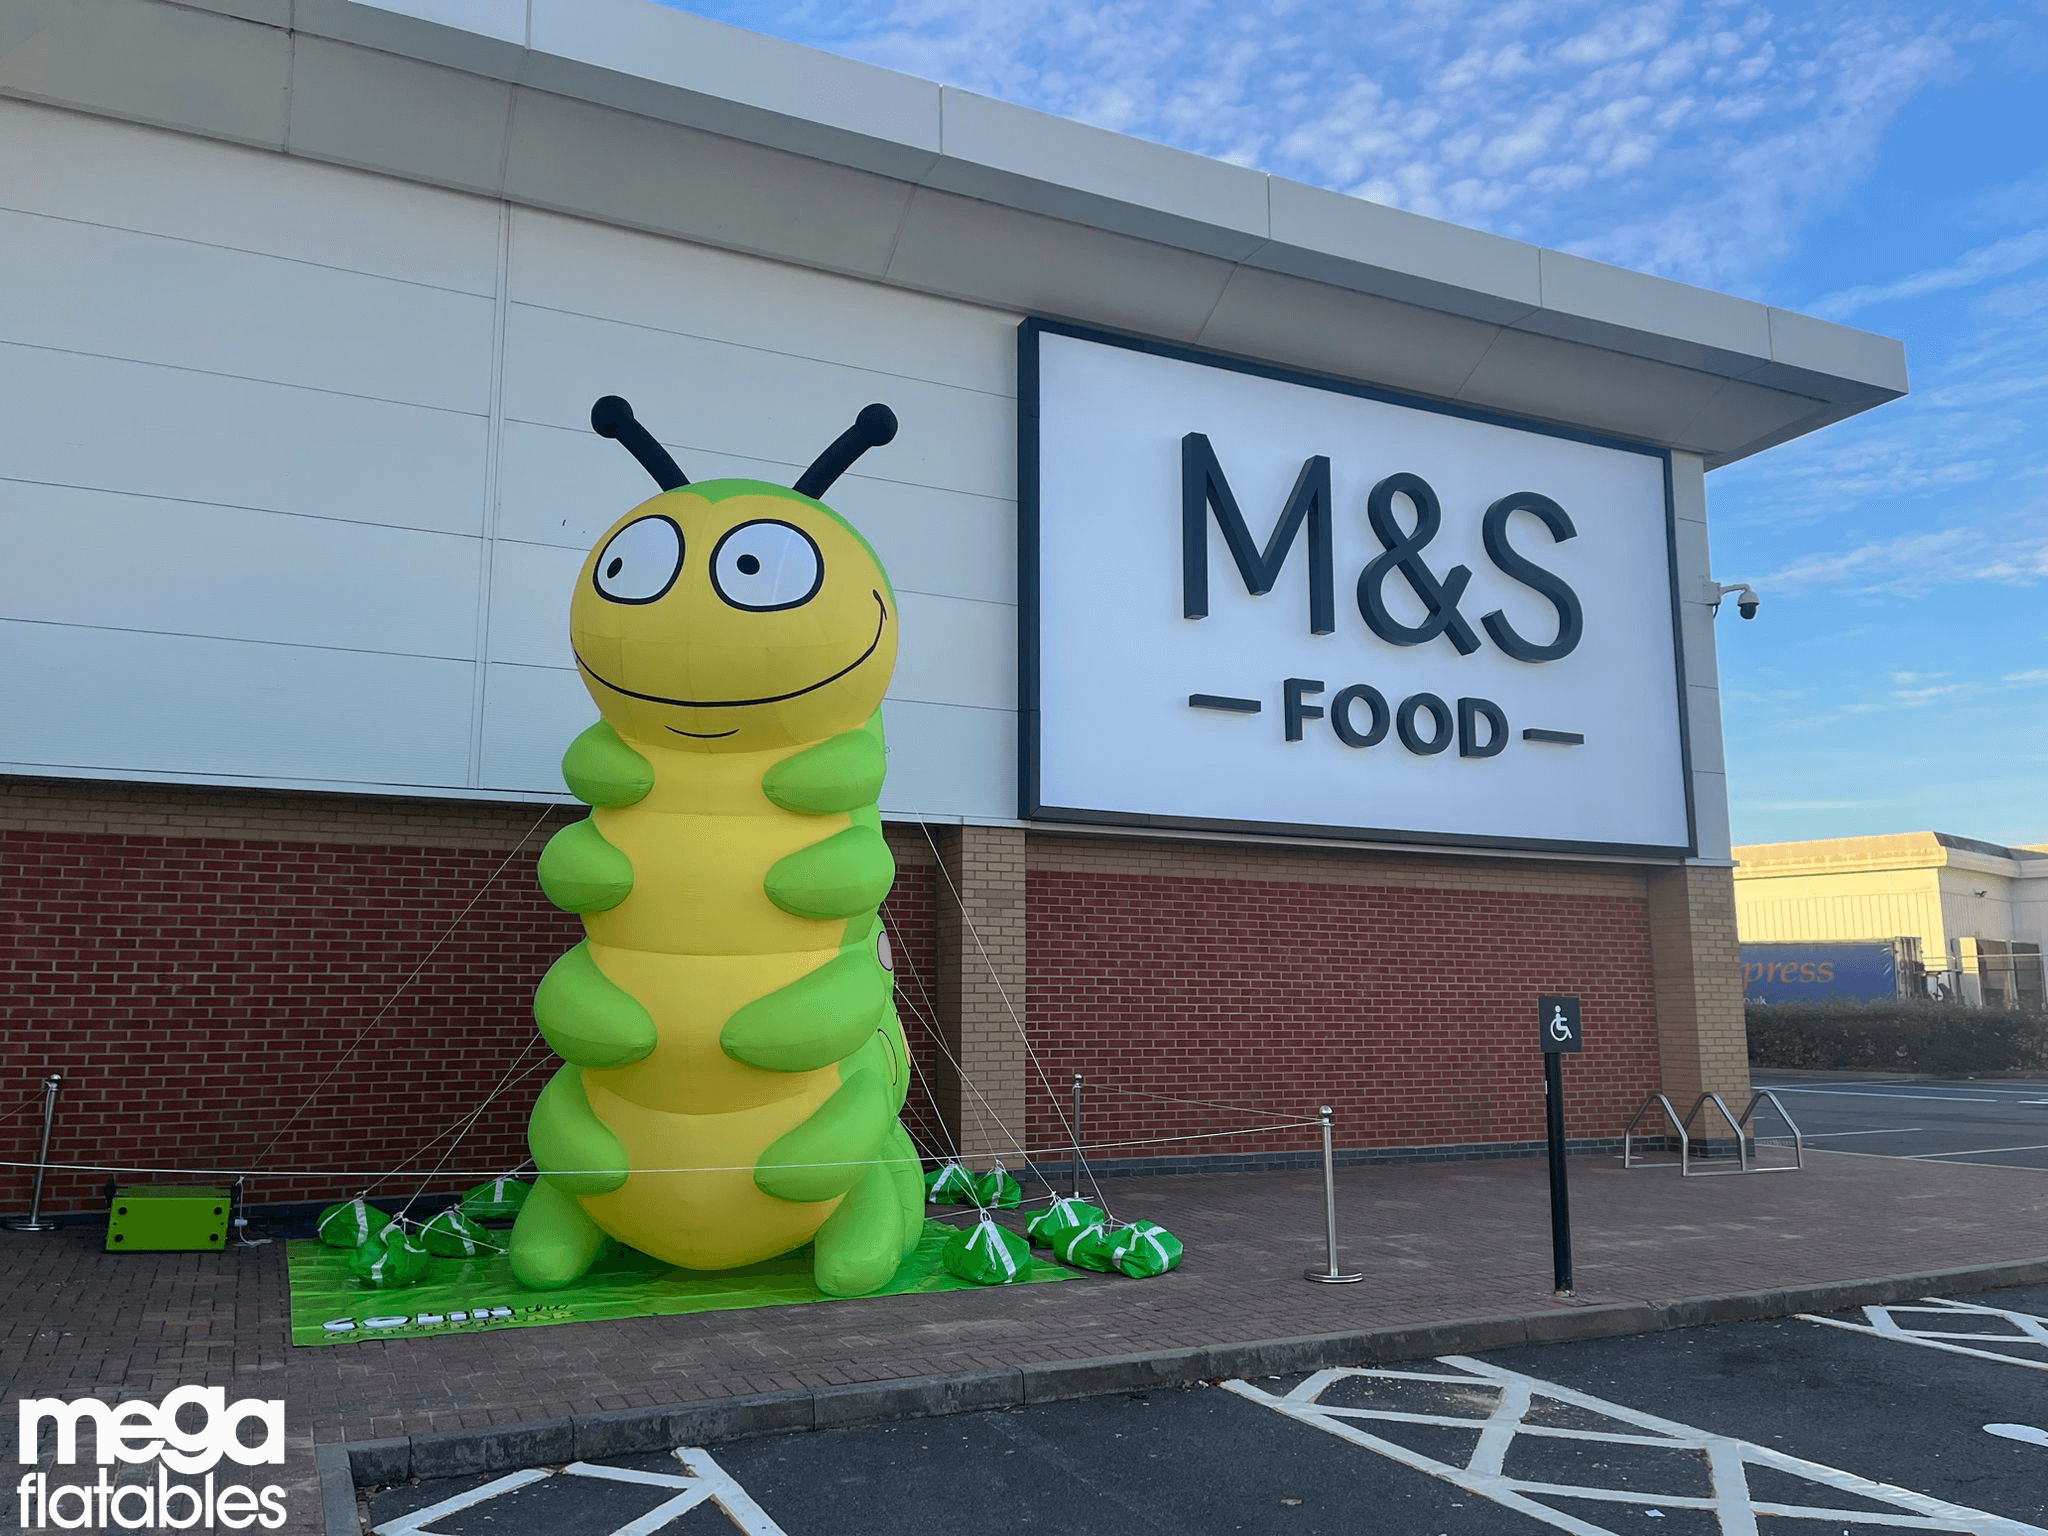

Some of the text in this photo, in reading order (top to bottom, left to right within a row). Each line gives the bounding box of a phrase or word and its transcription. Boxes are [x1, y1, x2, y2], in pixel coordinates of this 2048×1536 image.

[1182, 432, 1583, 663] M&S
[1285, 678, 1509, 757] FOOD
[1742, 961, 1834, 992] press
